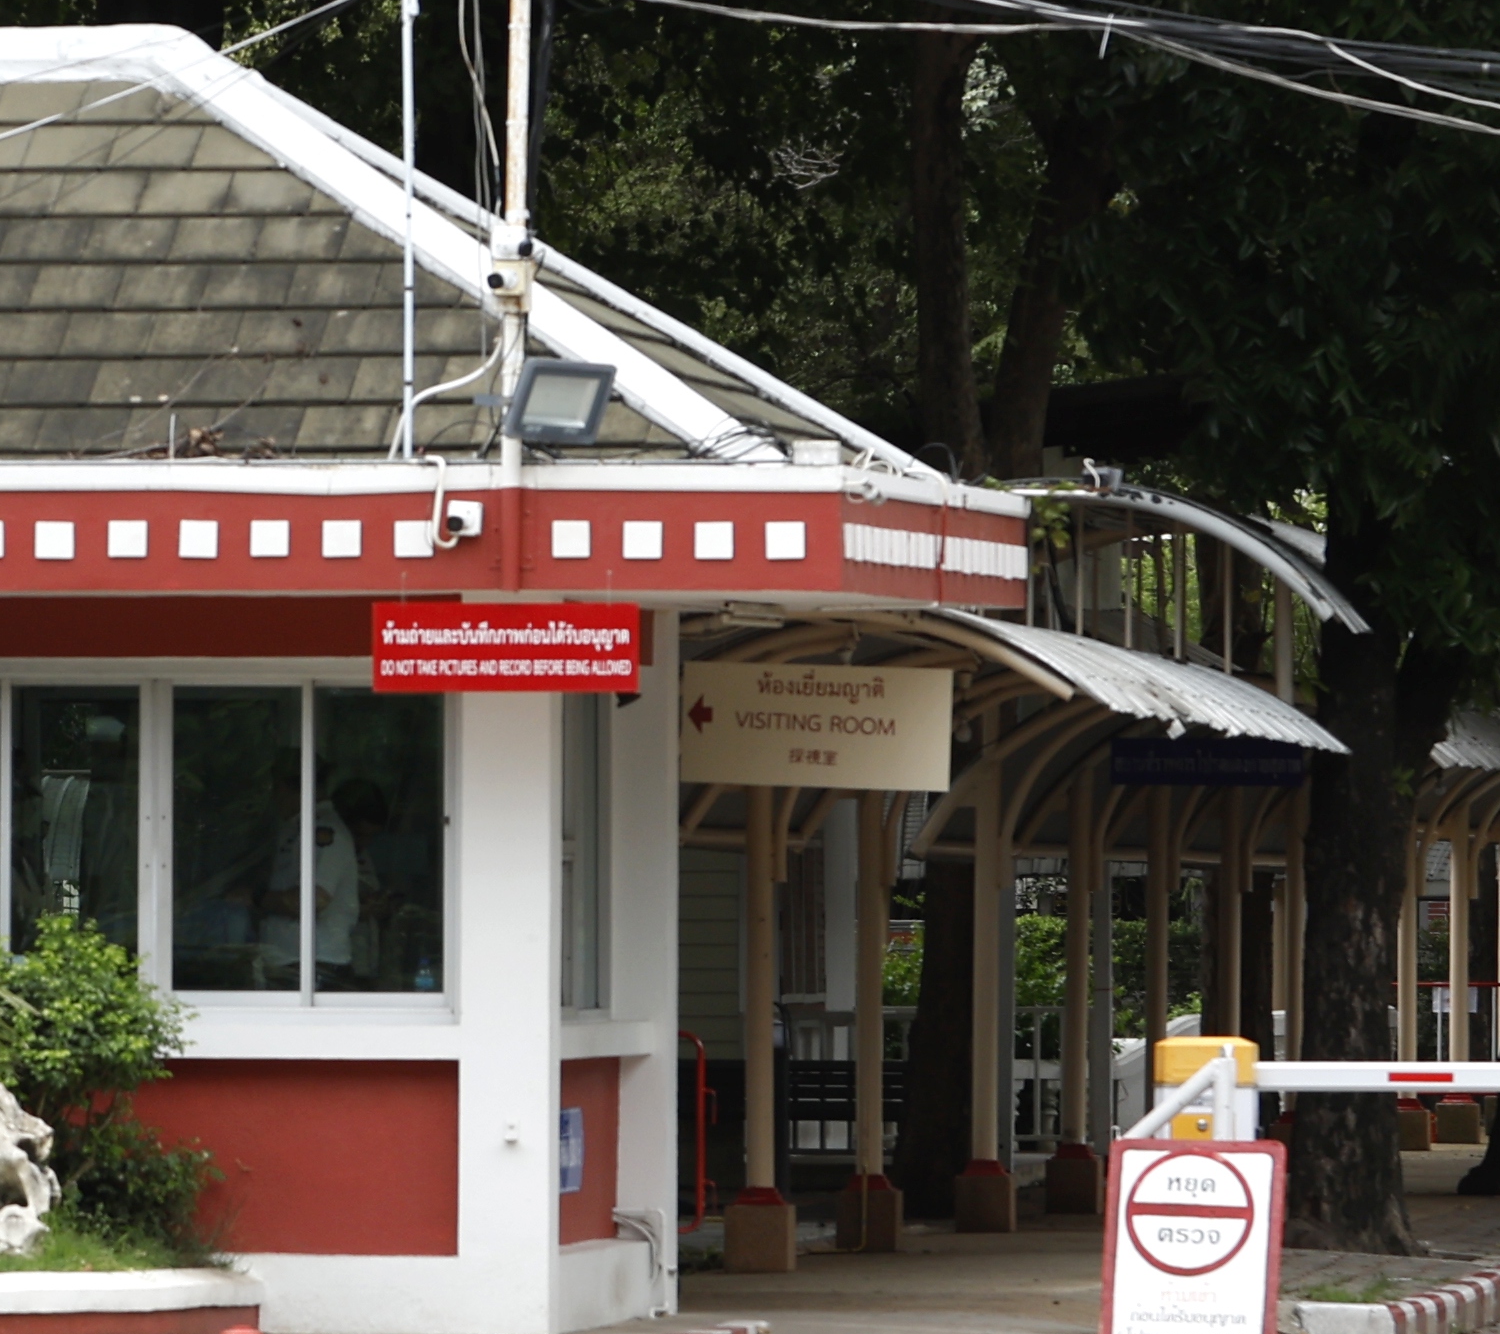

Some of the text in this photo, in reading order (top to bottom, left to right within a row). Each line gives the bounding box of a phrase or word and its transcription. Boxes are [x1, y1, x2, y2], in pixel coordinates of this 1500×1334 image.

[380, 659, 633, 676] DO NOT TAKE PICTURES AND RECORD BEFORE BEING ALLOWED
[757, 669, 885, 704] ห้องเยี่ยมญาติ
[735, 711, 896, 736] VISITING ROOM
[1167, 1176, 1216, 1198] หยุด
[1157, 1227, 1221, 1245] ตรวจ
